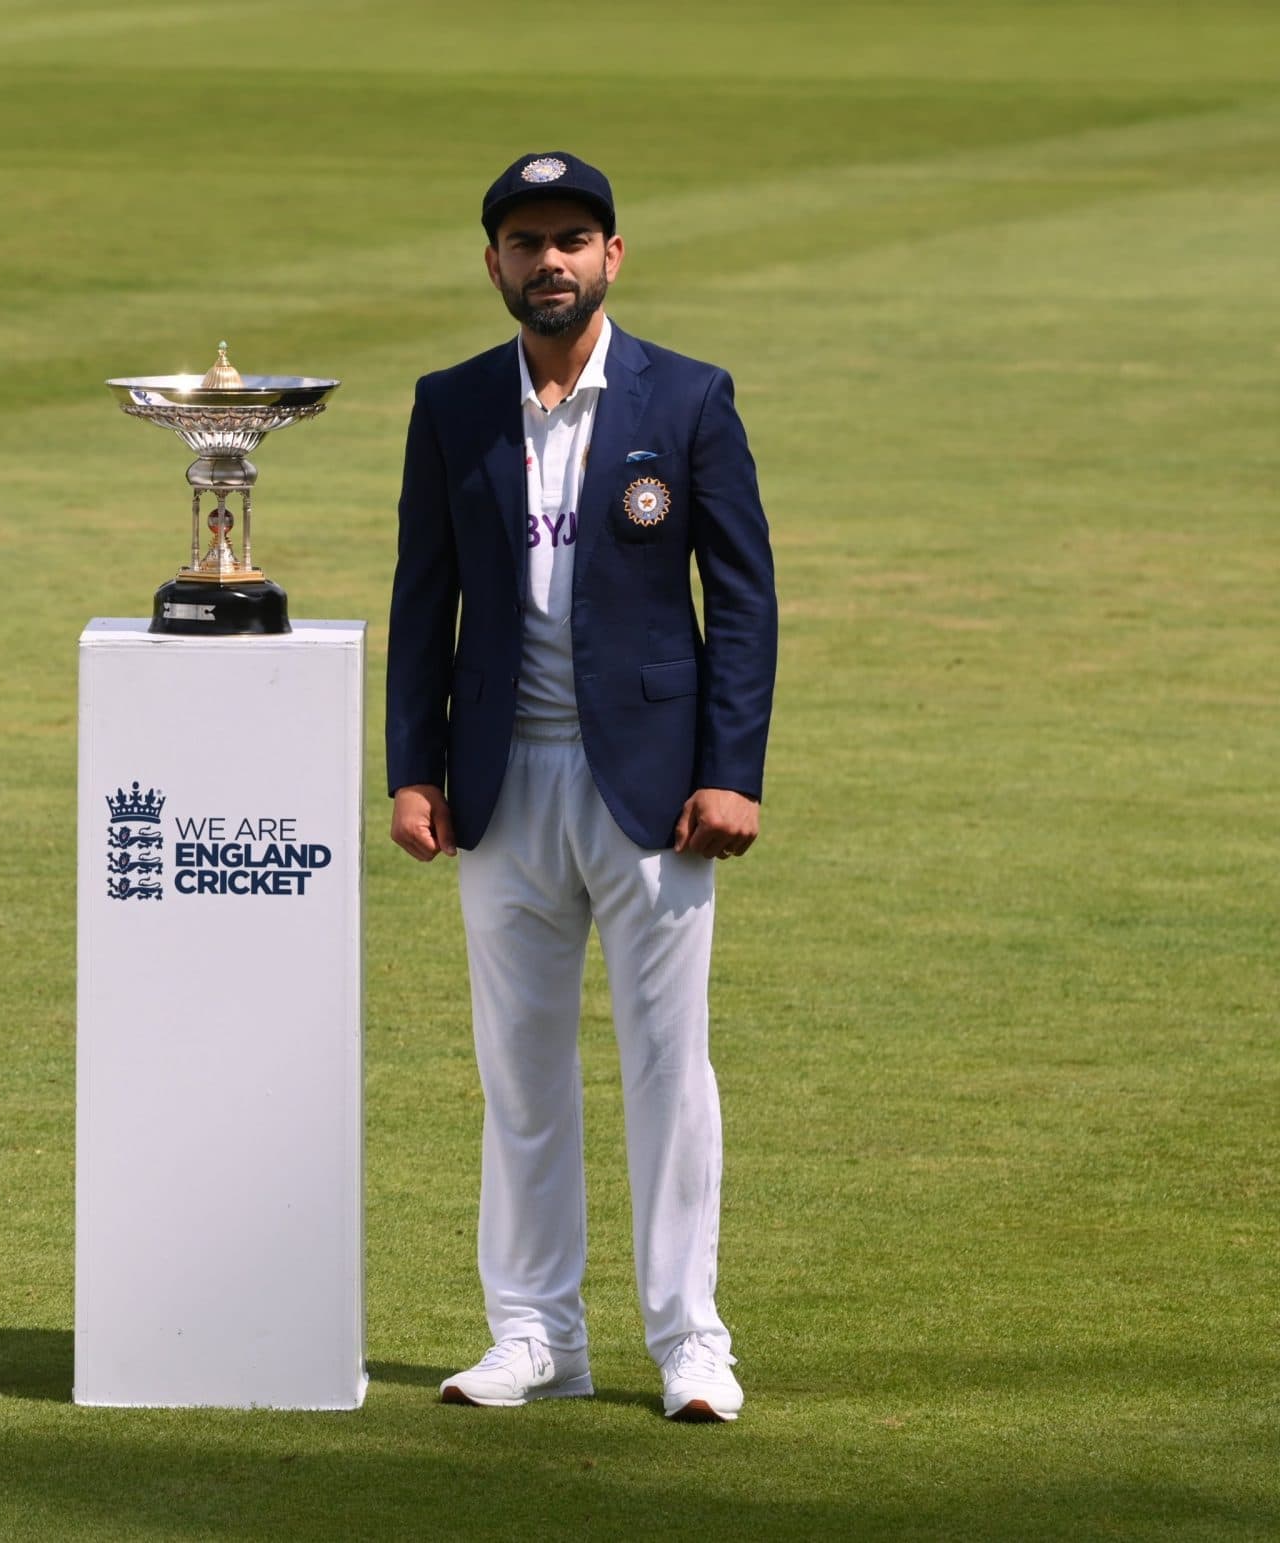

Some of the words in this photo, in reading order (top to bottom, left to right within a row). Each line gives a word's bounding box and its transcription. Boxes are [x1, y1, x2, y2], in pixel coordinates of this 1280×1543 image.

[175, 817, 226, 841] WE
[234, 818, 297, 841] ARE
[175, 842, 332, 868] ENGLAND
[174, 869, 312, 895] CRICKET
